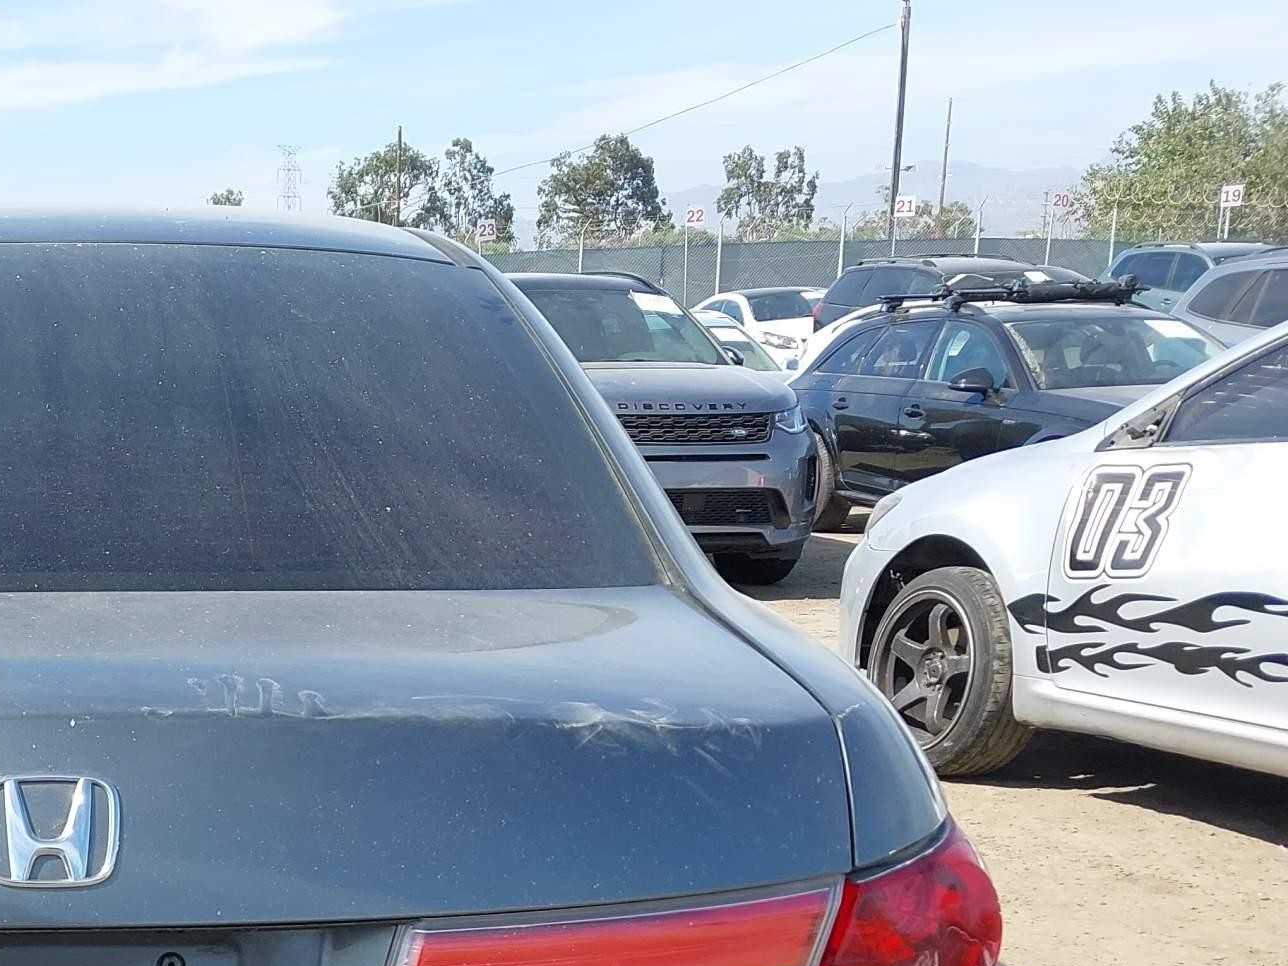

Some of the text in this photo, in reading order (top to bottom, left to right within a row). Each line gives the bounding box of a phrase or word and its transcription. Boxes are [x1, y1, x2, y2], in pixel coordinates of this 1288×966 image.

[1053, 193, 1069, 207] 20
[1223, 189, 1241, 203] 19
[896, 199, 914, 213] 21
[686, 208, 704, 223] 22
[478, 223, 495, 237] 23
[617, 402, 747, 411] DISCOVERY
[1066, 466, 1191, 576] 03
